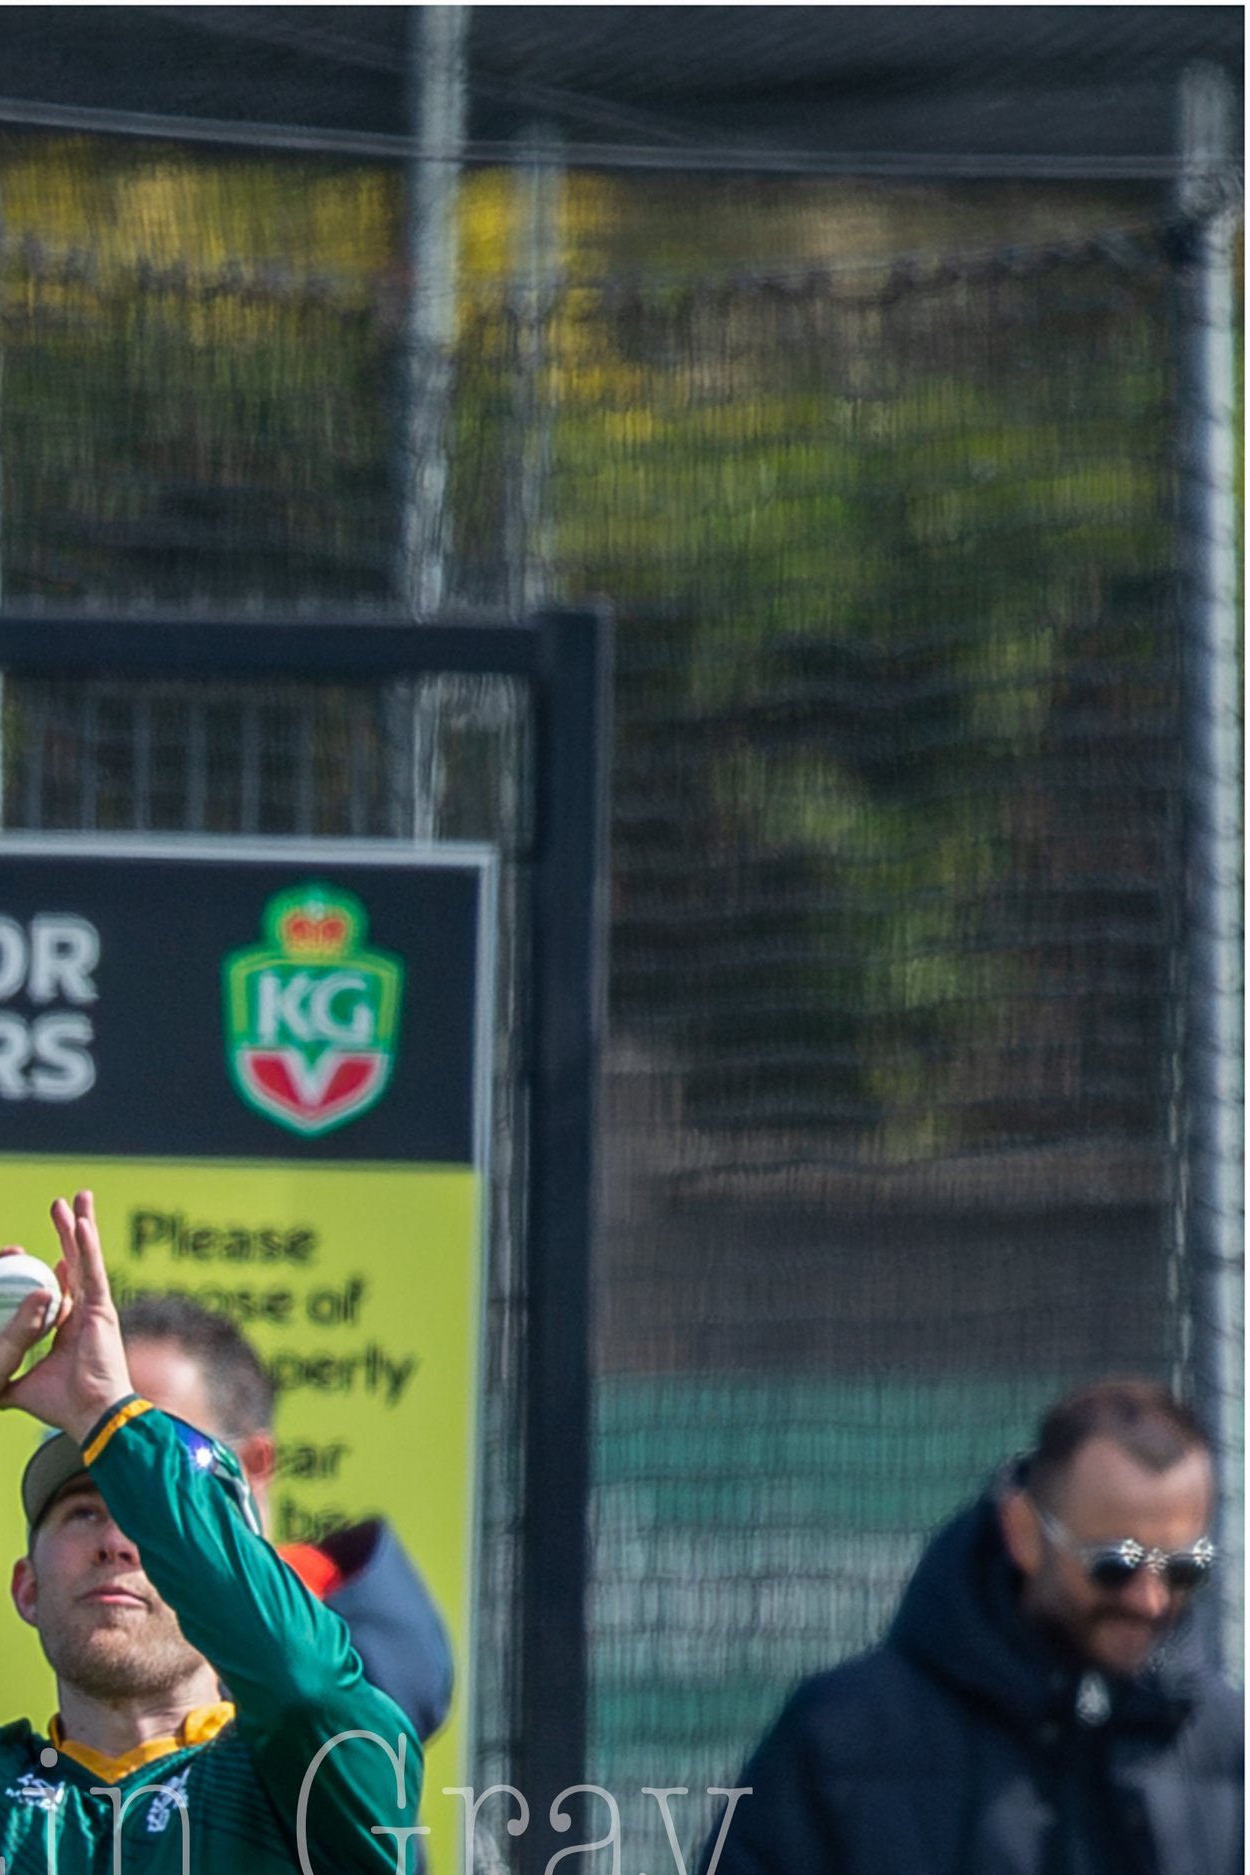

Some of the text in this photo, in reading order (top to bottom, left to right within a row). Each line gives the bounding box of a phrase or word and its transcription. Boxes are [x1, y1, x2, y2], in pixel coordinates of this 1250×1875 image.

[257, 970, 375, 1047] KG
[129, 1208, 317, 1260] Please
[305, 1276, 366, 1322] of
